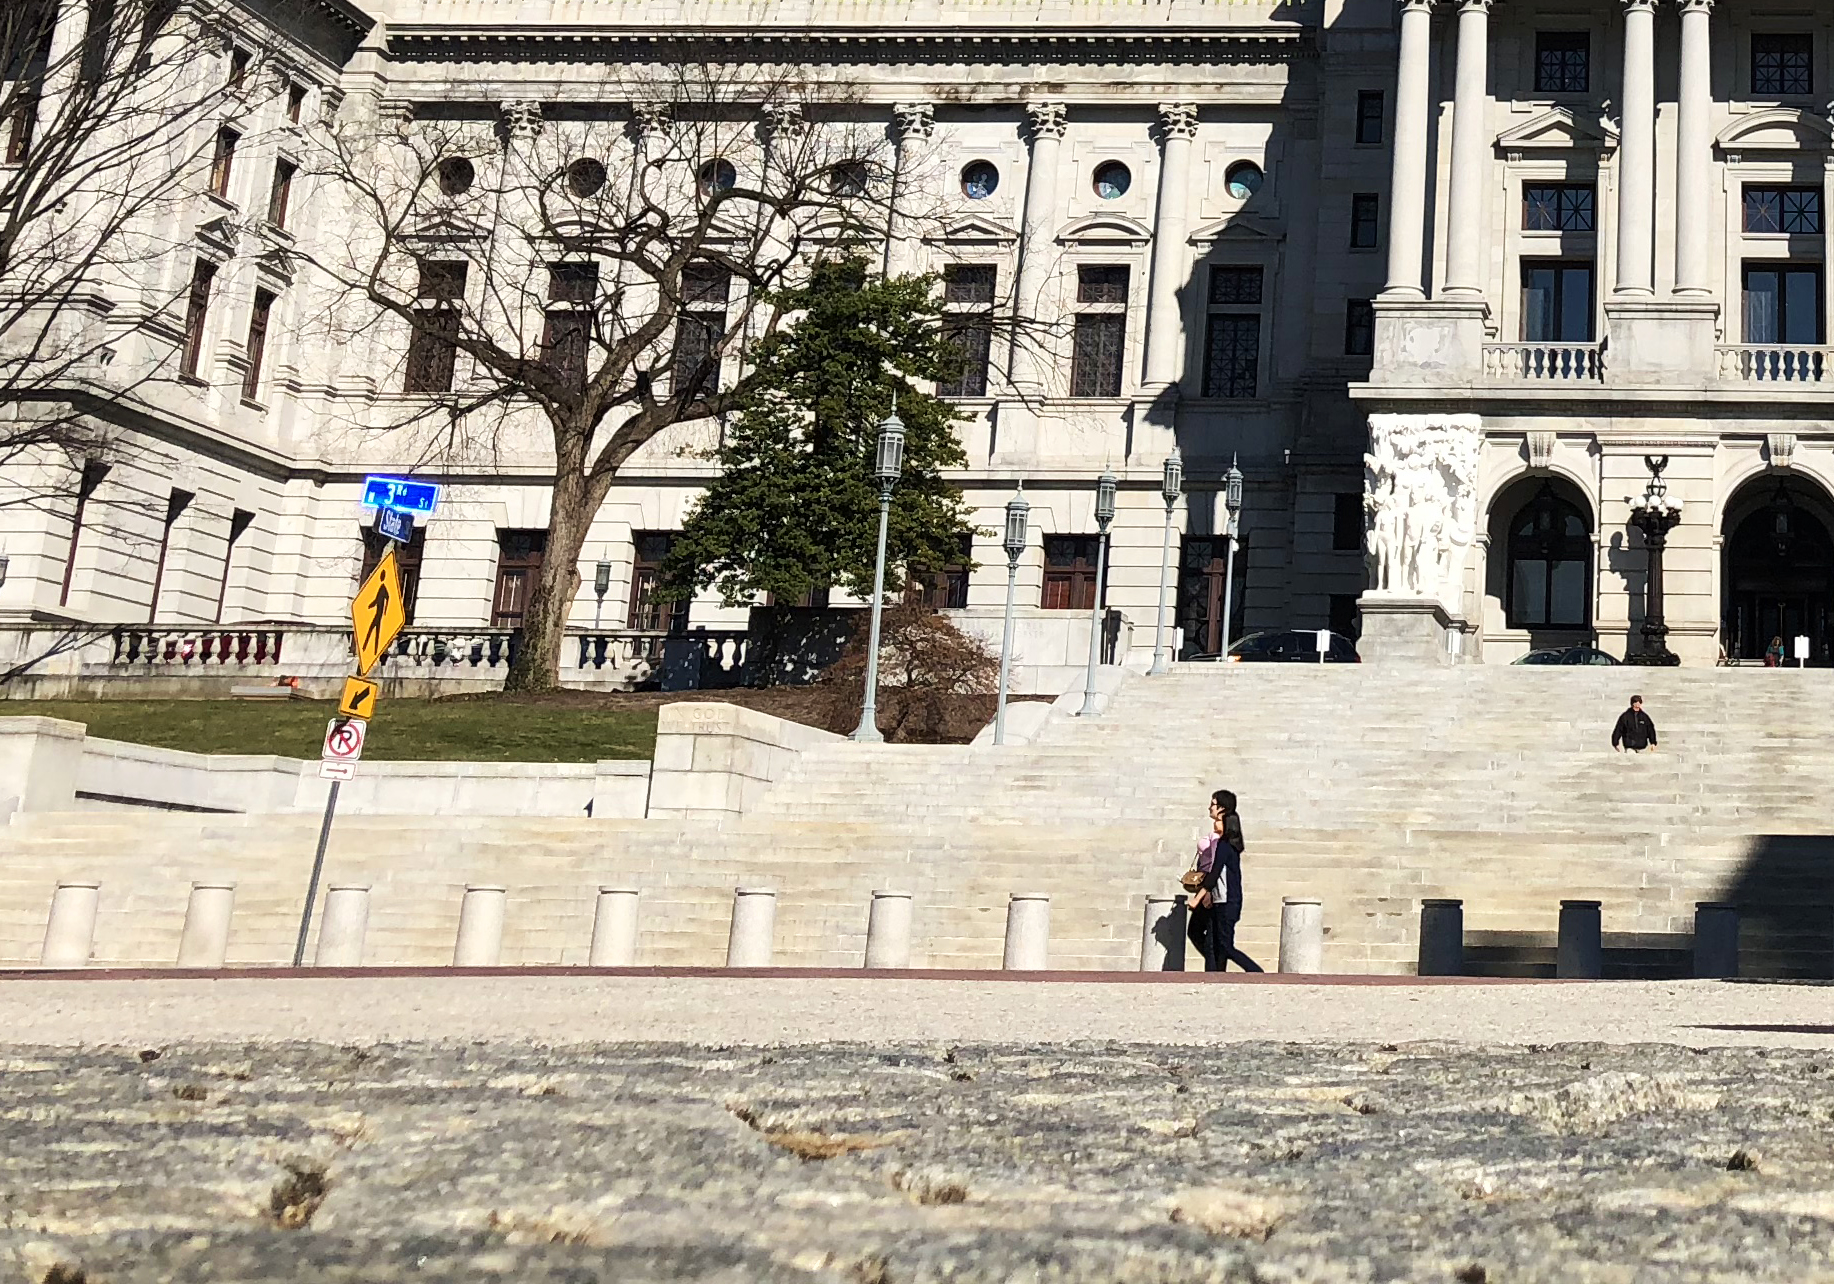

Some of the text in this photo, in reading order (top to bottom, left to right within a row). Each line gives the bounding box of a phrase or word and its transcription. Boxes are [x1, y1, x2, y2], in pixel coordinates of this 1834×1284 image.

[367, 491, 376, 503] N
[383, 509, 402, 536] State
[692, 707, 727, 720] GOD
[690, 720, 731, 734] TRUST
